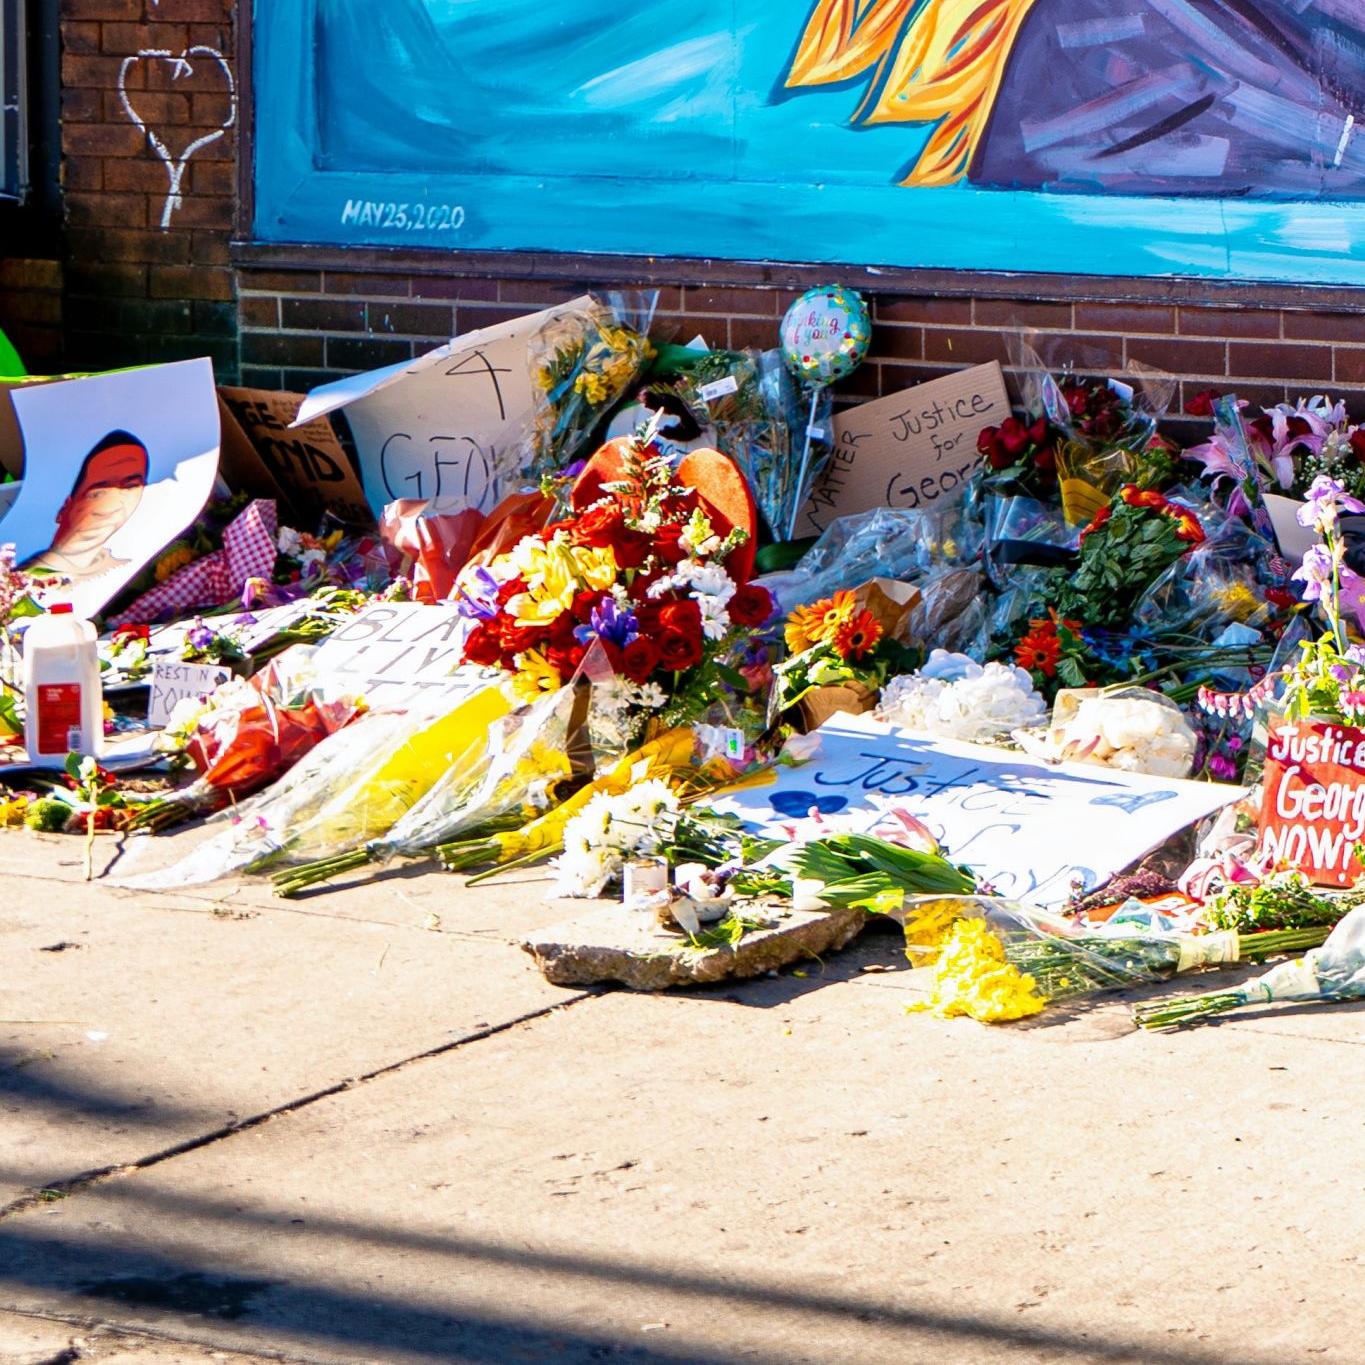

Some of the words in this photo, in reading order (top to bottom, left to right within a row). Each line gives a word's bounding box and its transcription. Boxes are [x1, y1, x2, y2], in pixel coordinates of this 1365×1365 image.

[1333, 114, 1355, 168] I
[889, 394, 994, 442] Justice
[930, 432, 964, 462] for
[806, 429, 873, 533] MATTER
[886, 454, 984, 509] Geor
[332, 609, 462, 641] BLA
